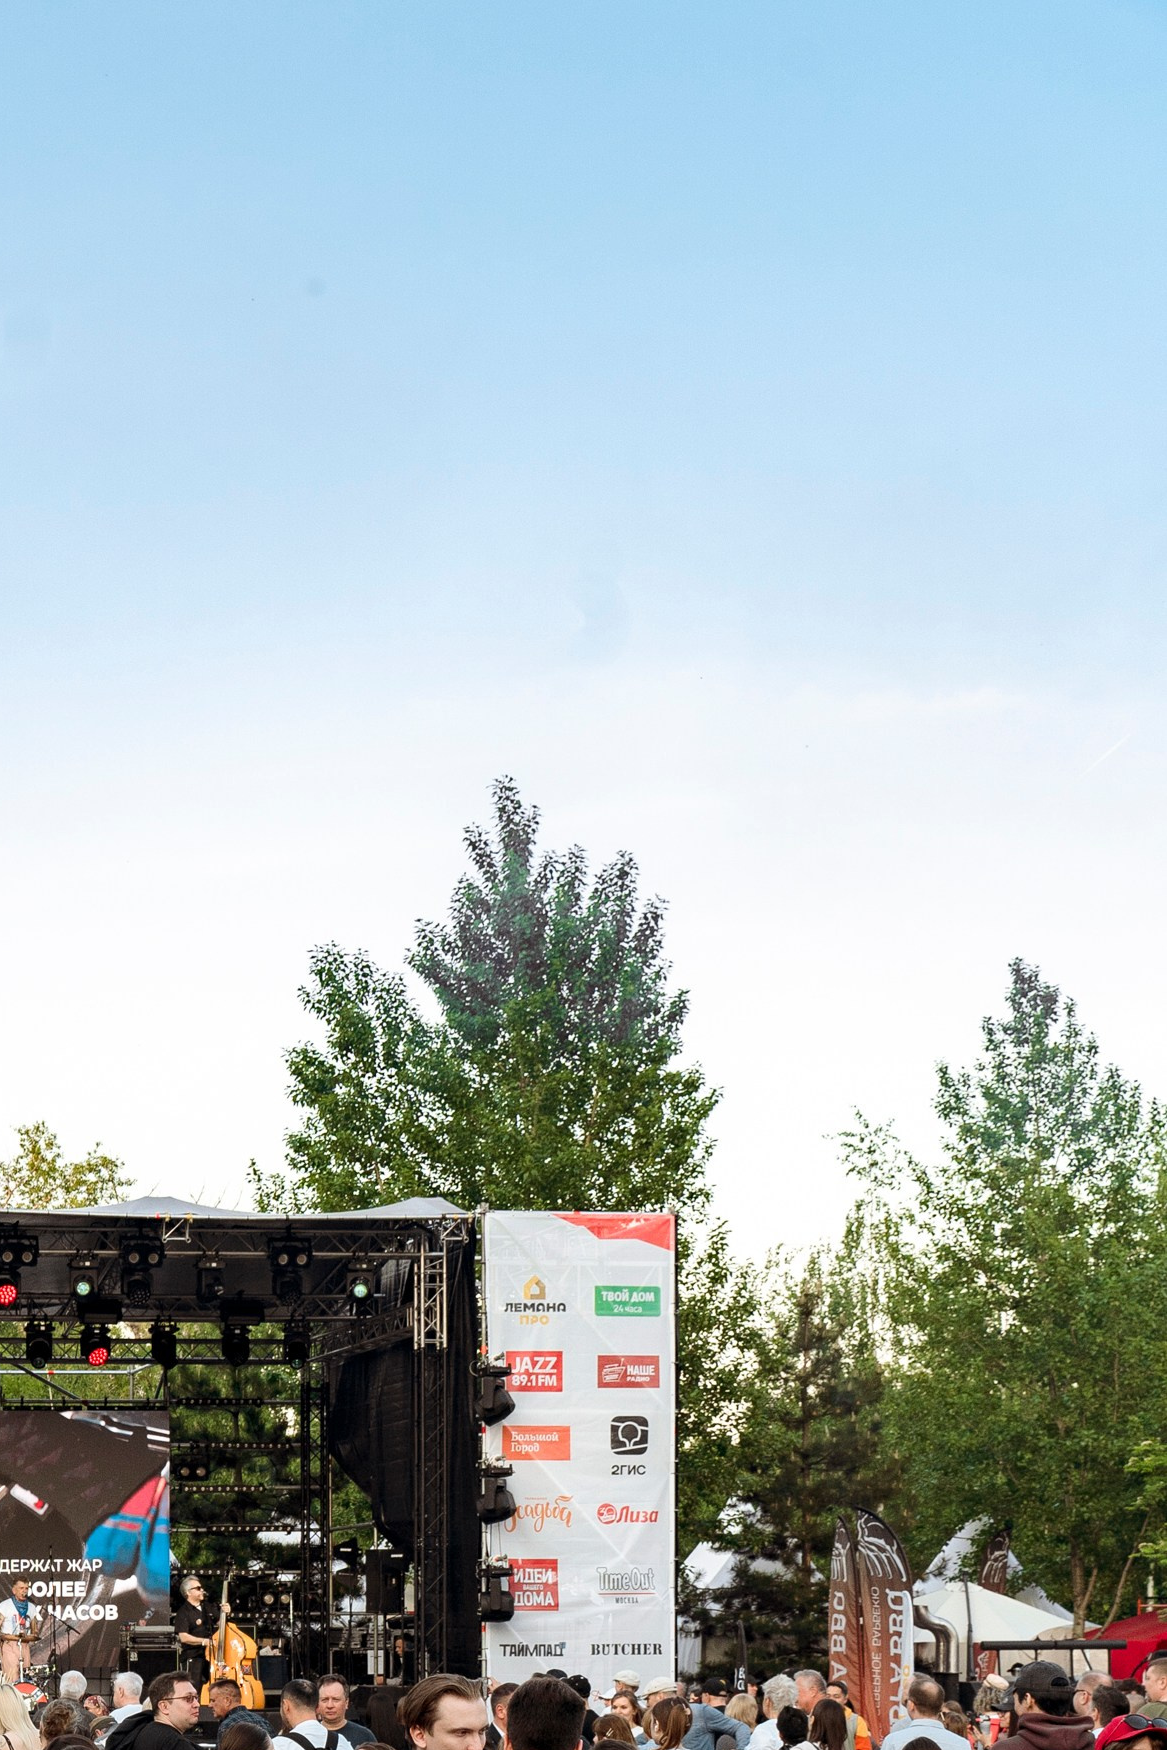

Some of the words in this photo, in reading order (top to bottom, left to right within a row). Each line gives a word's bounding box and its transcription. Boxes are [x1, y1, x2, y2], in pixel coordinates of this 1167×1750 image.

[601, 1289, 629, 1302] ТВОЙ
[631, 1292, 655, 1303] ДОМ
[504, 1302, 566, 1313] ЛЕМАНА
[613, 1305, 623, 1313] 24
[520, 1315, 550, 1325] ПРО
[512, 1356, 557, 1373] JAZZ
[627, 1365, 655, 1376] НАШЕ
[511, 1431, 559, 1442] Большой
[511, 1442, 540, 1454] Город
[611, 1464, 646, 1476] 2ГИС
[616, 1505, 659, 1524] Лиза
[66, 1559, 103, 1572] ЖАР
[513, 1567, 553, 1584] ИДЕИ
[514, 1592, 555, 1606] ДОМА
[47, 1604, 119, 1621] ЧАСОВ
[499, 1642, 566, 1657] ТАЙМПАД
[591, 1643, 662, 1655] BUTCHER
